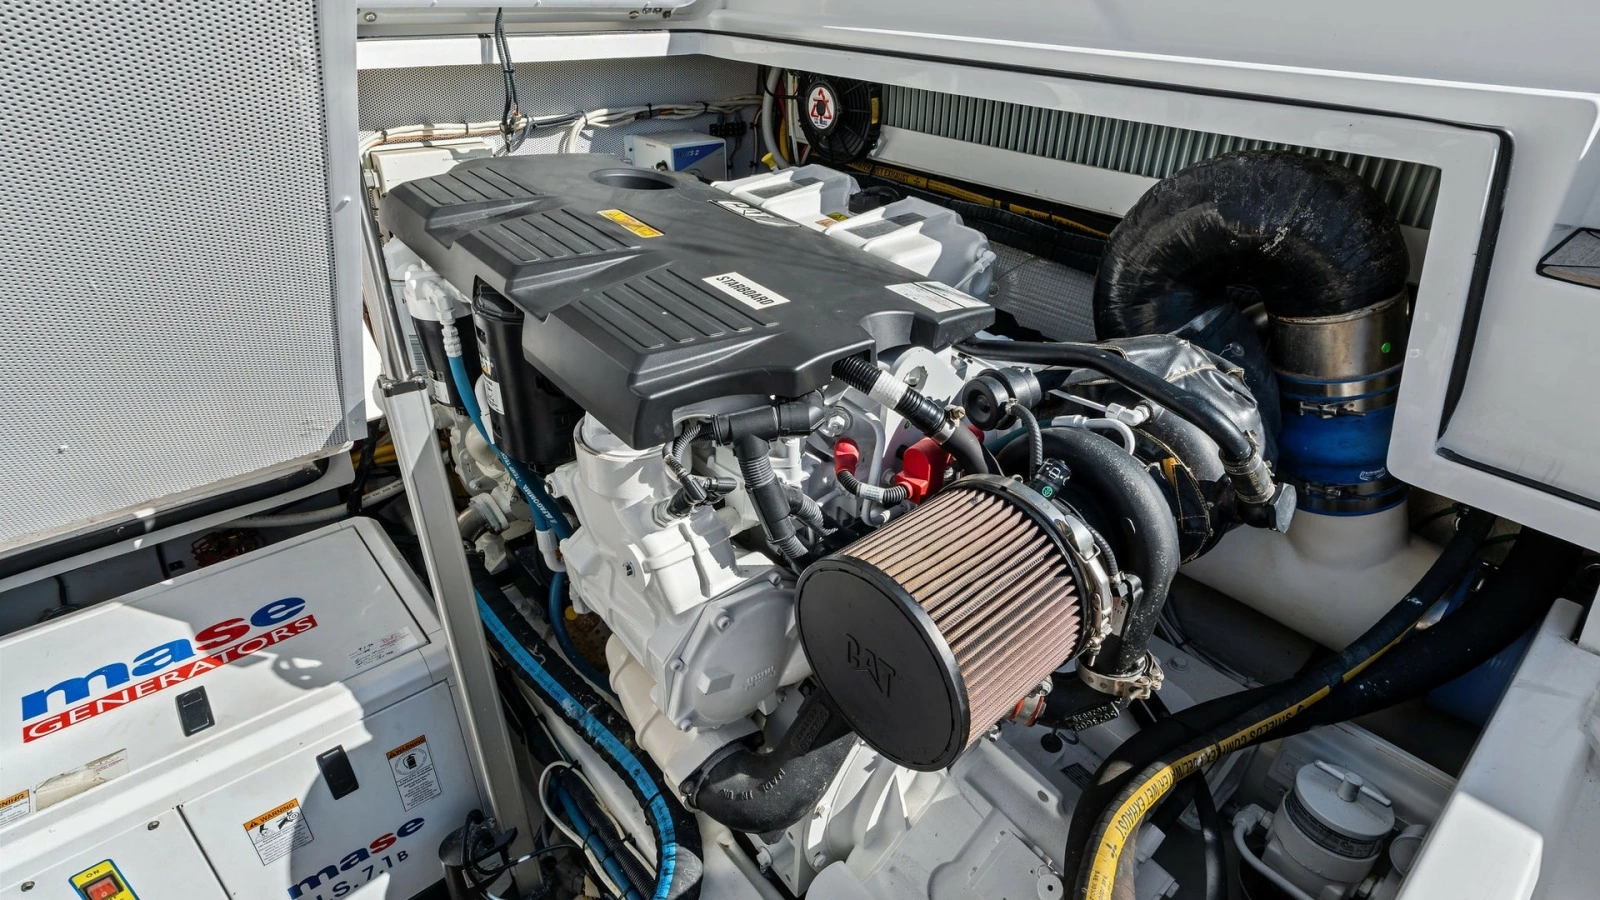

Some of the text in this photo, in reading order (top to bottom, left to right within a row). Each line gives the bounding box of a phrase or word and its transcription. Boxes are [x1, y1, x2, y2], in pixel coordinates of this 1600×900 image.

[716, 276, 775, 306] STARBOARD
[21, 597, 306, 722] mase
[28, 614, 313, 738] GENERATORS
[845, 633, 897, 698] CAT
[397, 736, 425, 754] WARNING
[260, 802, 295, 823] WARNING
[741, 789, 754, 800] IN
[1115, 795, 1146, 841] EXHAUST
[86, 869, 99, 878] ON
[287, 817, 425, 900] mase
